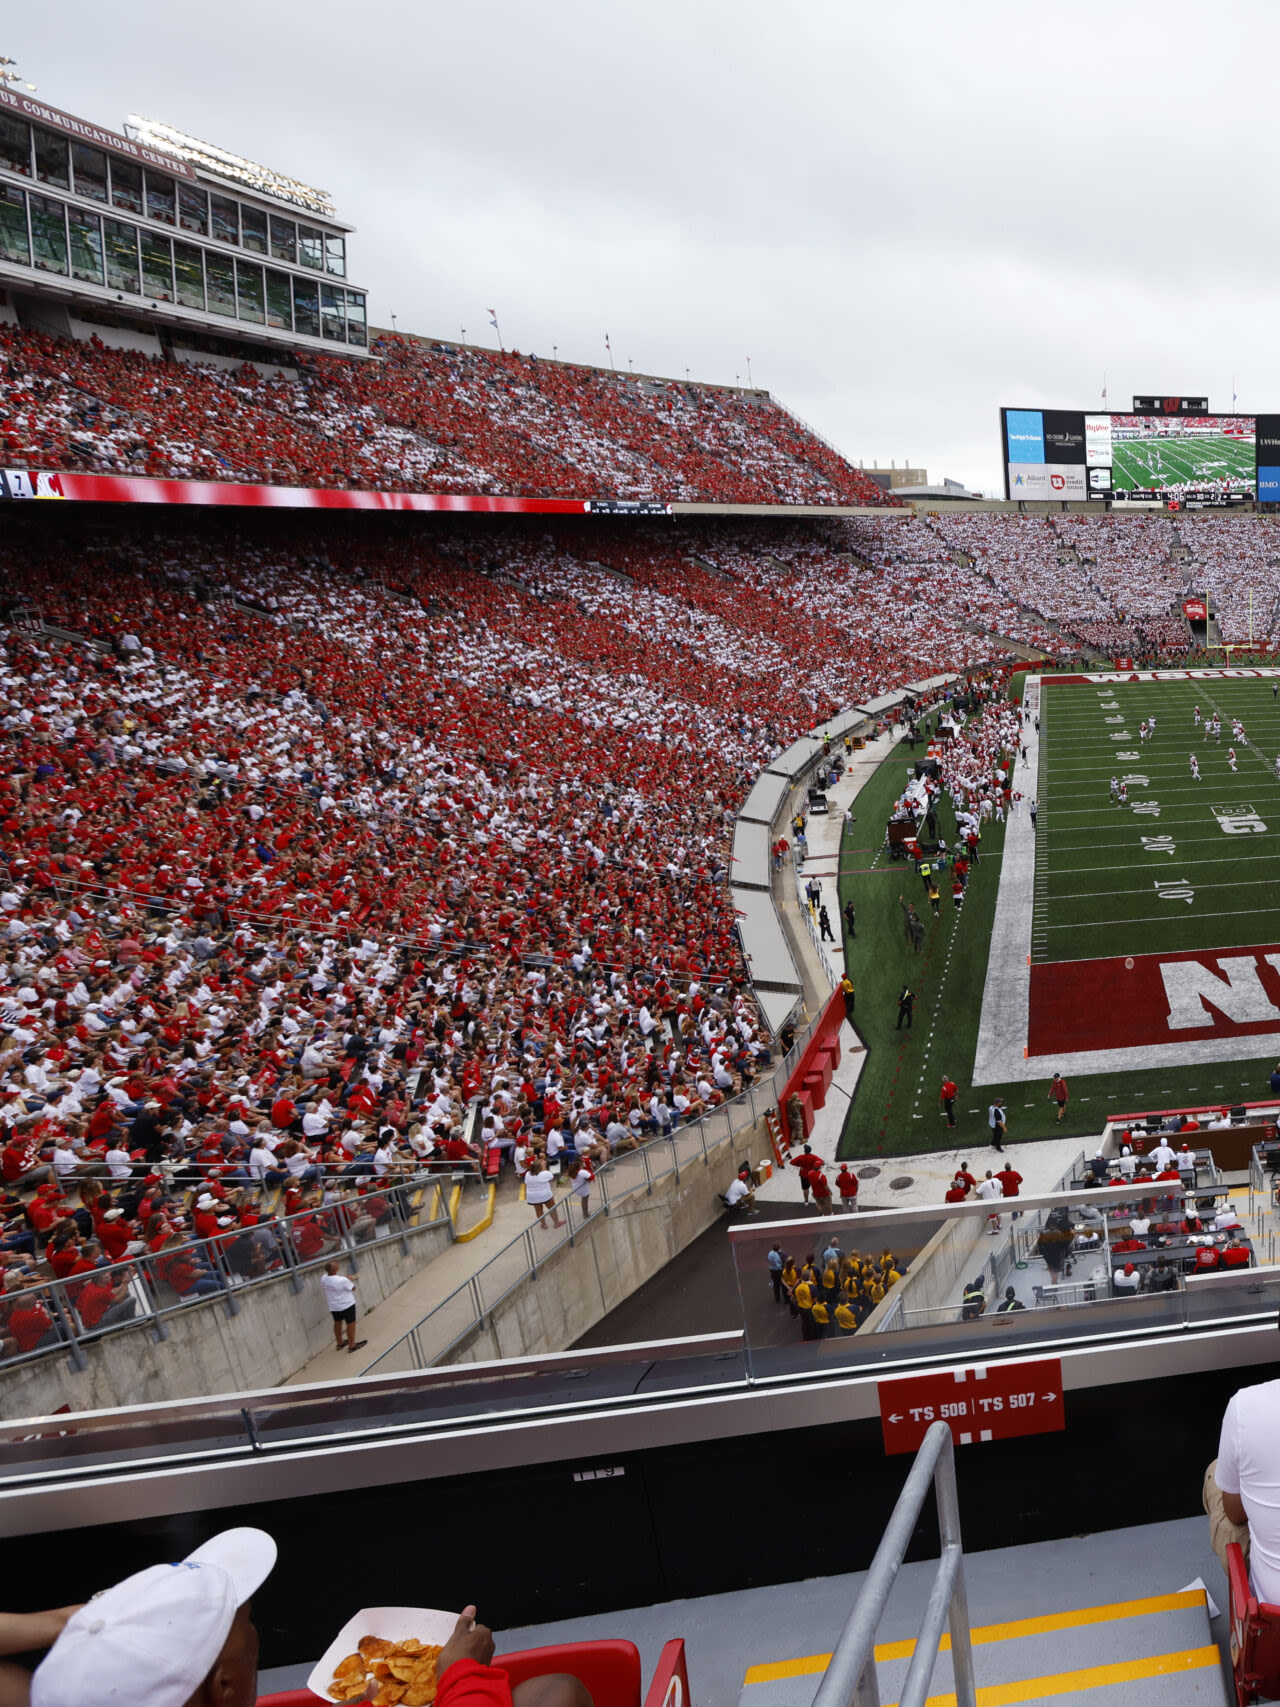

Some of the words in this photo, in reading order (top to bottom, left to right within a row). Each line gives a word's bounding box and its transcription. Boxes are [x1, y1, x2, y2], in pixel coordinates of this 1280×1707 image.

[23, 101, 138, 155] COMMUNICATIONS
[142, 150, 187, 174] CENTER
[14, 475, 22, 491] 7
[1167, 492, 1184, 501] 4:06
[1130, 801, 1161, 814] 30
[1140, 835, 1176, 851] 20
[1154, 878, 1194, 899] 10
[909, 1406, 935, 1422] TS
[940, 1401, 967, 1418] 508
[979, 1397, 1003, 1412] TS
[1009, 1392, 1035, 1408] 507
